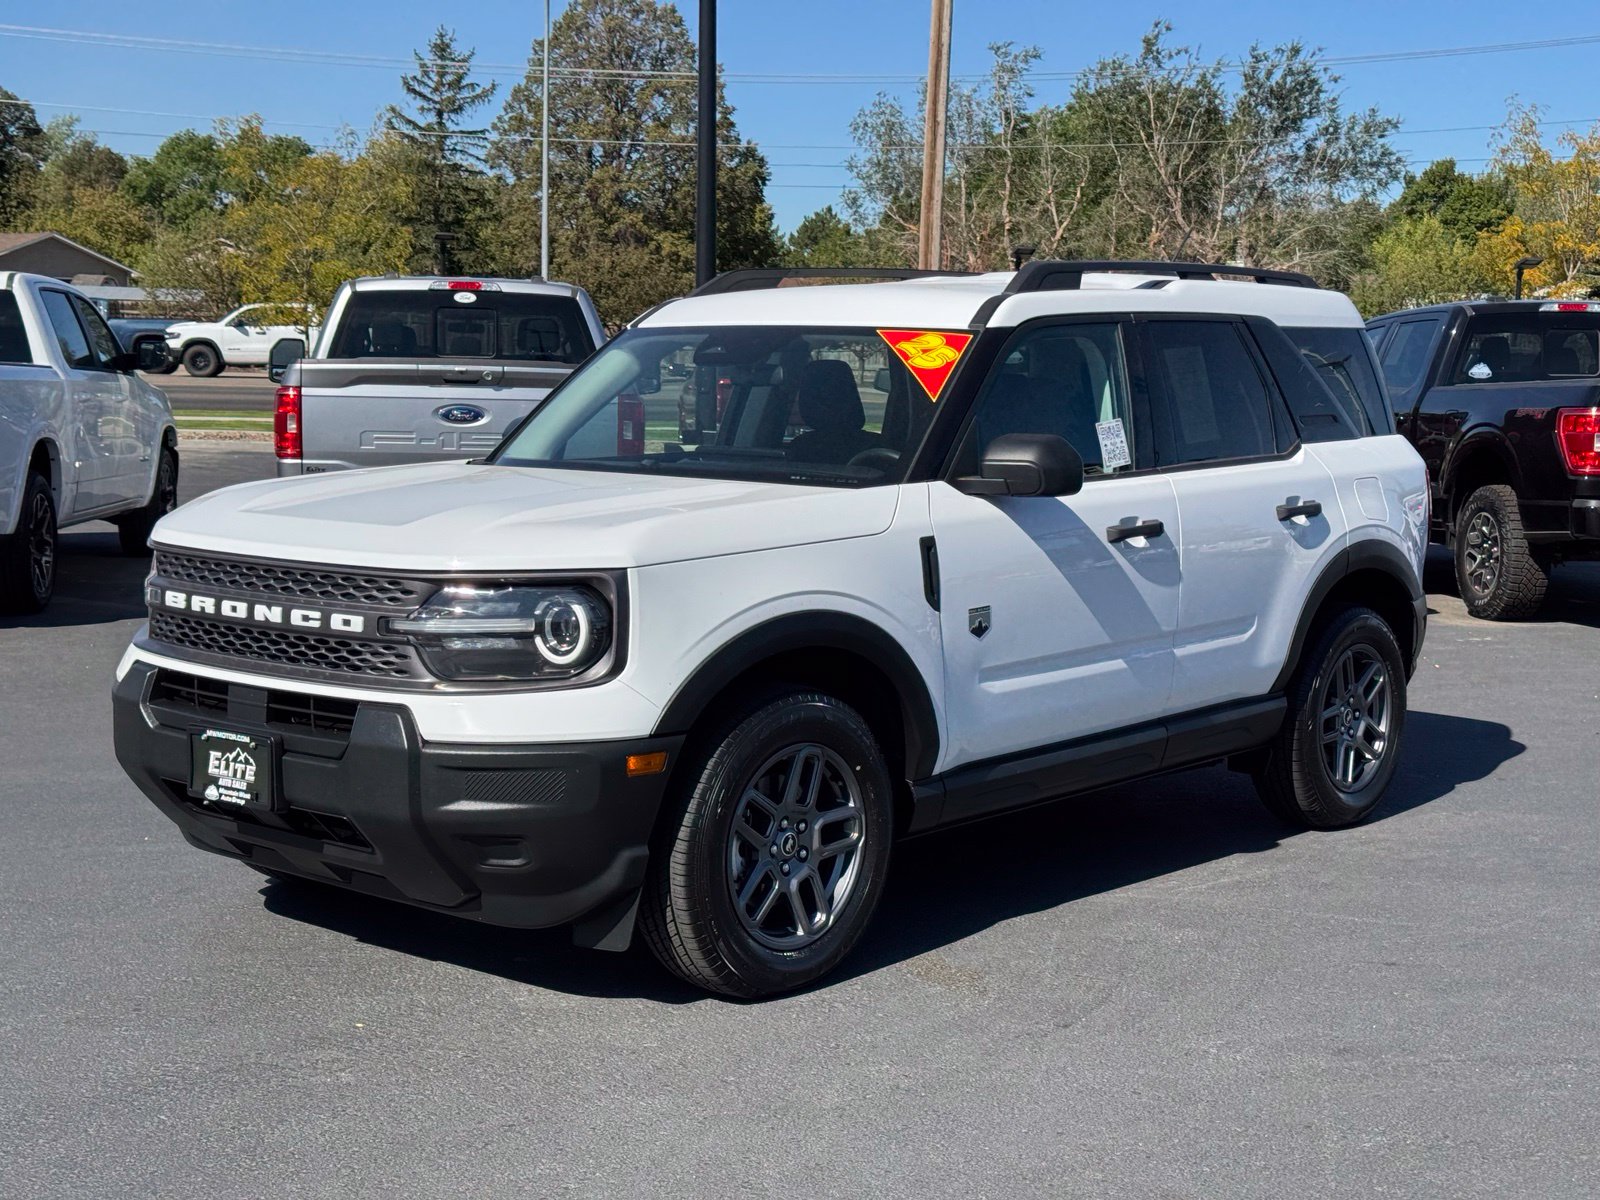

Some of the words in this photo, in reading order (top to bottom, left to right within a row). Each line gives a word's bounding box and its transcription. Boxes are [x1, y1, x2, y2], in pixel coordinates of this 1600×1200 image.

[896, 333, 959, 370] 25
[165, 590, 364, 633] BRONCO
[208, 751, 256, 782] ELITE
